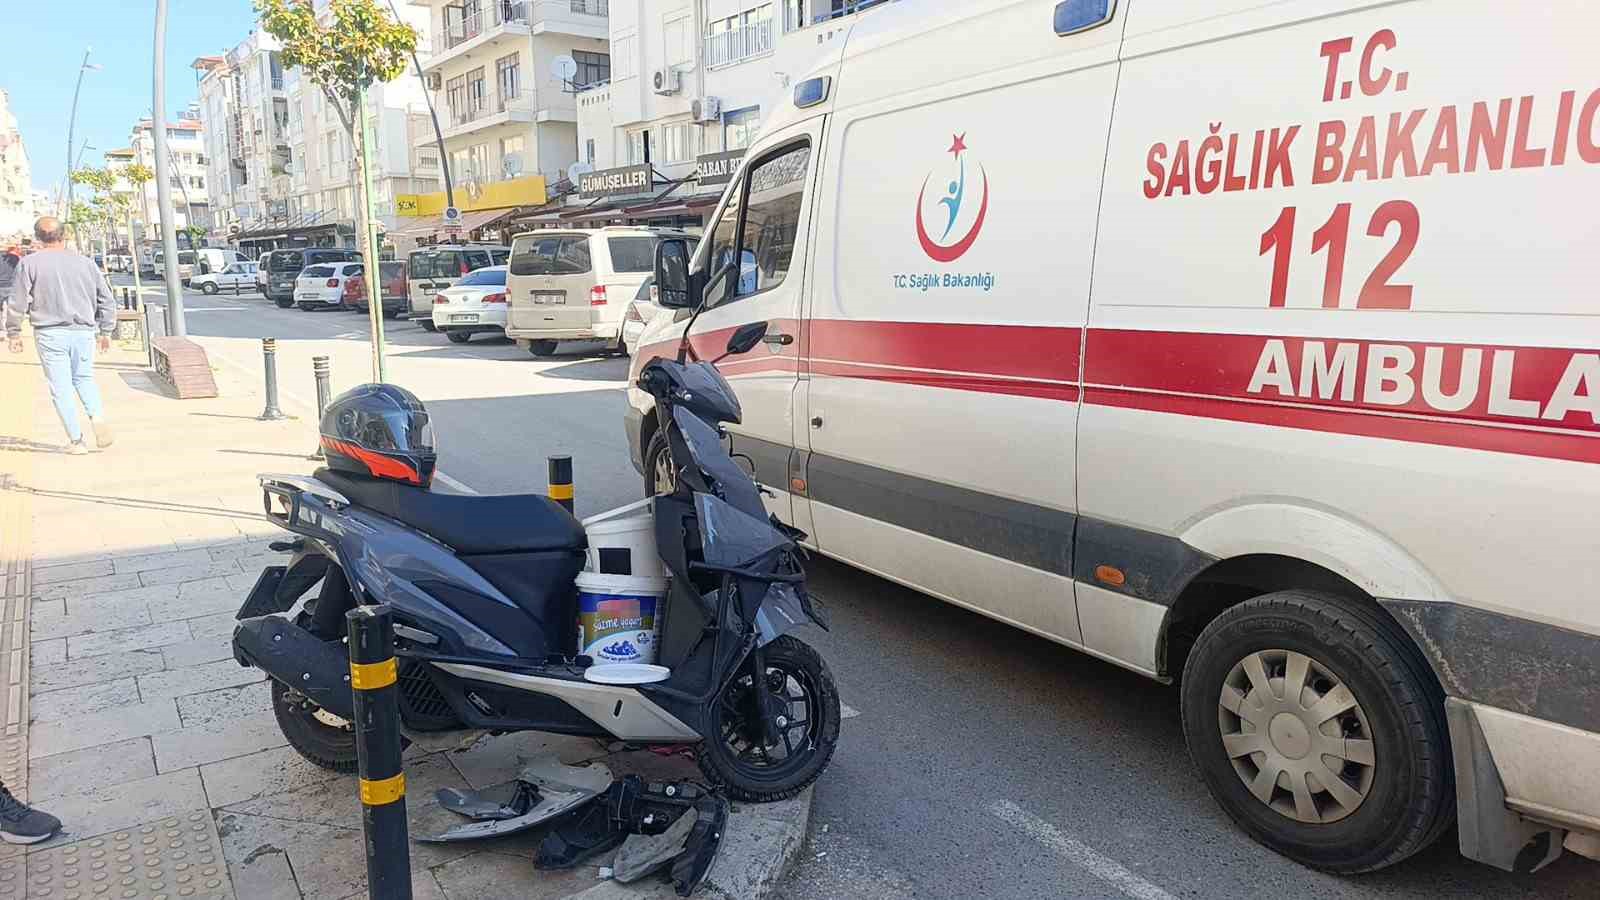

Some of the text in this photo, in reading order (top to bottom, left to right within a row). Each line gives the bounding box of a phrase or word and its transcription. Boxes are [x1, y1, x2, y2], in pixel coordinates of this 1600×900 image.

[1320, 29, 1409, 102] T.C.
[1143, 122, 1302, 199] SAĞLIK
[909, 273, 940, 291] Sağlık
[943, 272, 995, 291] Bakanlığı
[1259, 199, 1420, 310] 112
